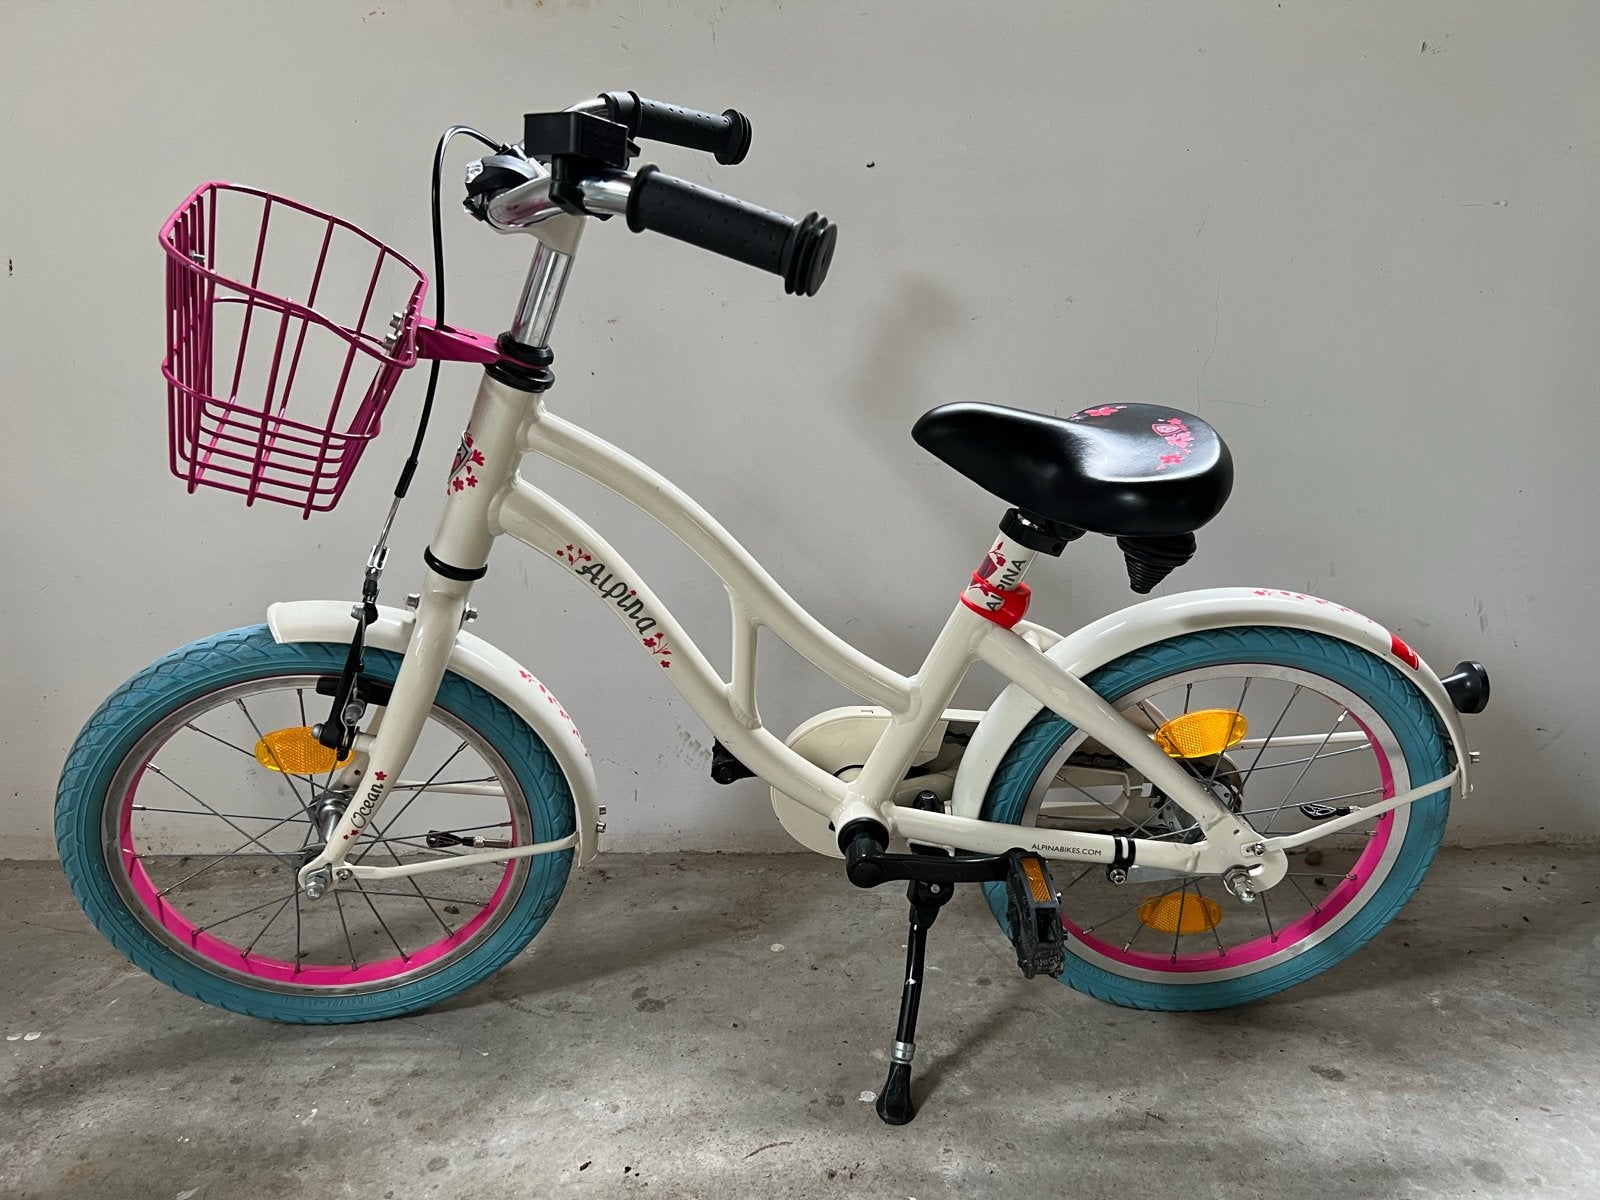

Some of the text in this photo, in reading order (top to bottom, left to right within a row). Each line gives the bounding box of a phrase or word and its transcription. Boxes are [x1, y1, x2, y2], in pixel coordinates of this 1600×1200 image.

[575, 563, 657, 635] Alpina
[351, 784, 384, 829] Ocean
[1031, 843, 1102, 856] ALPINABIKES.COM
